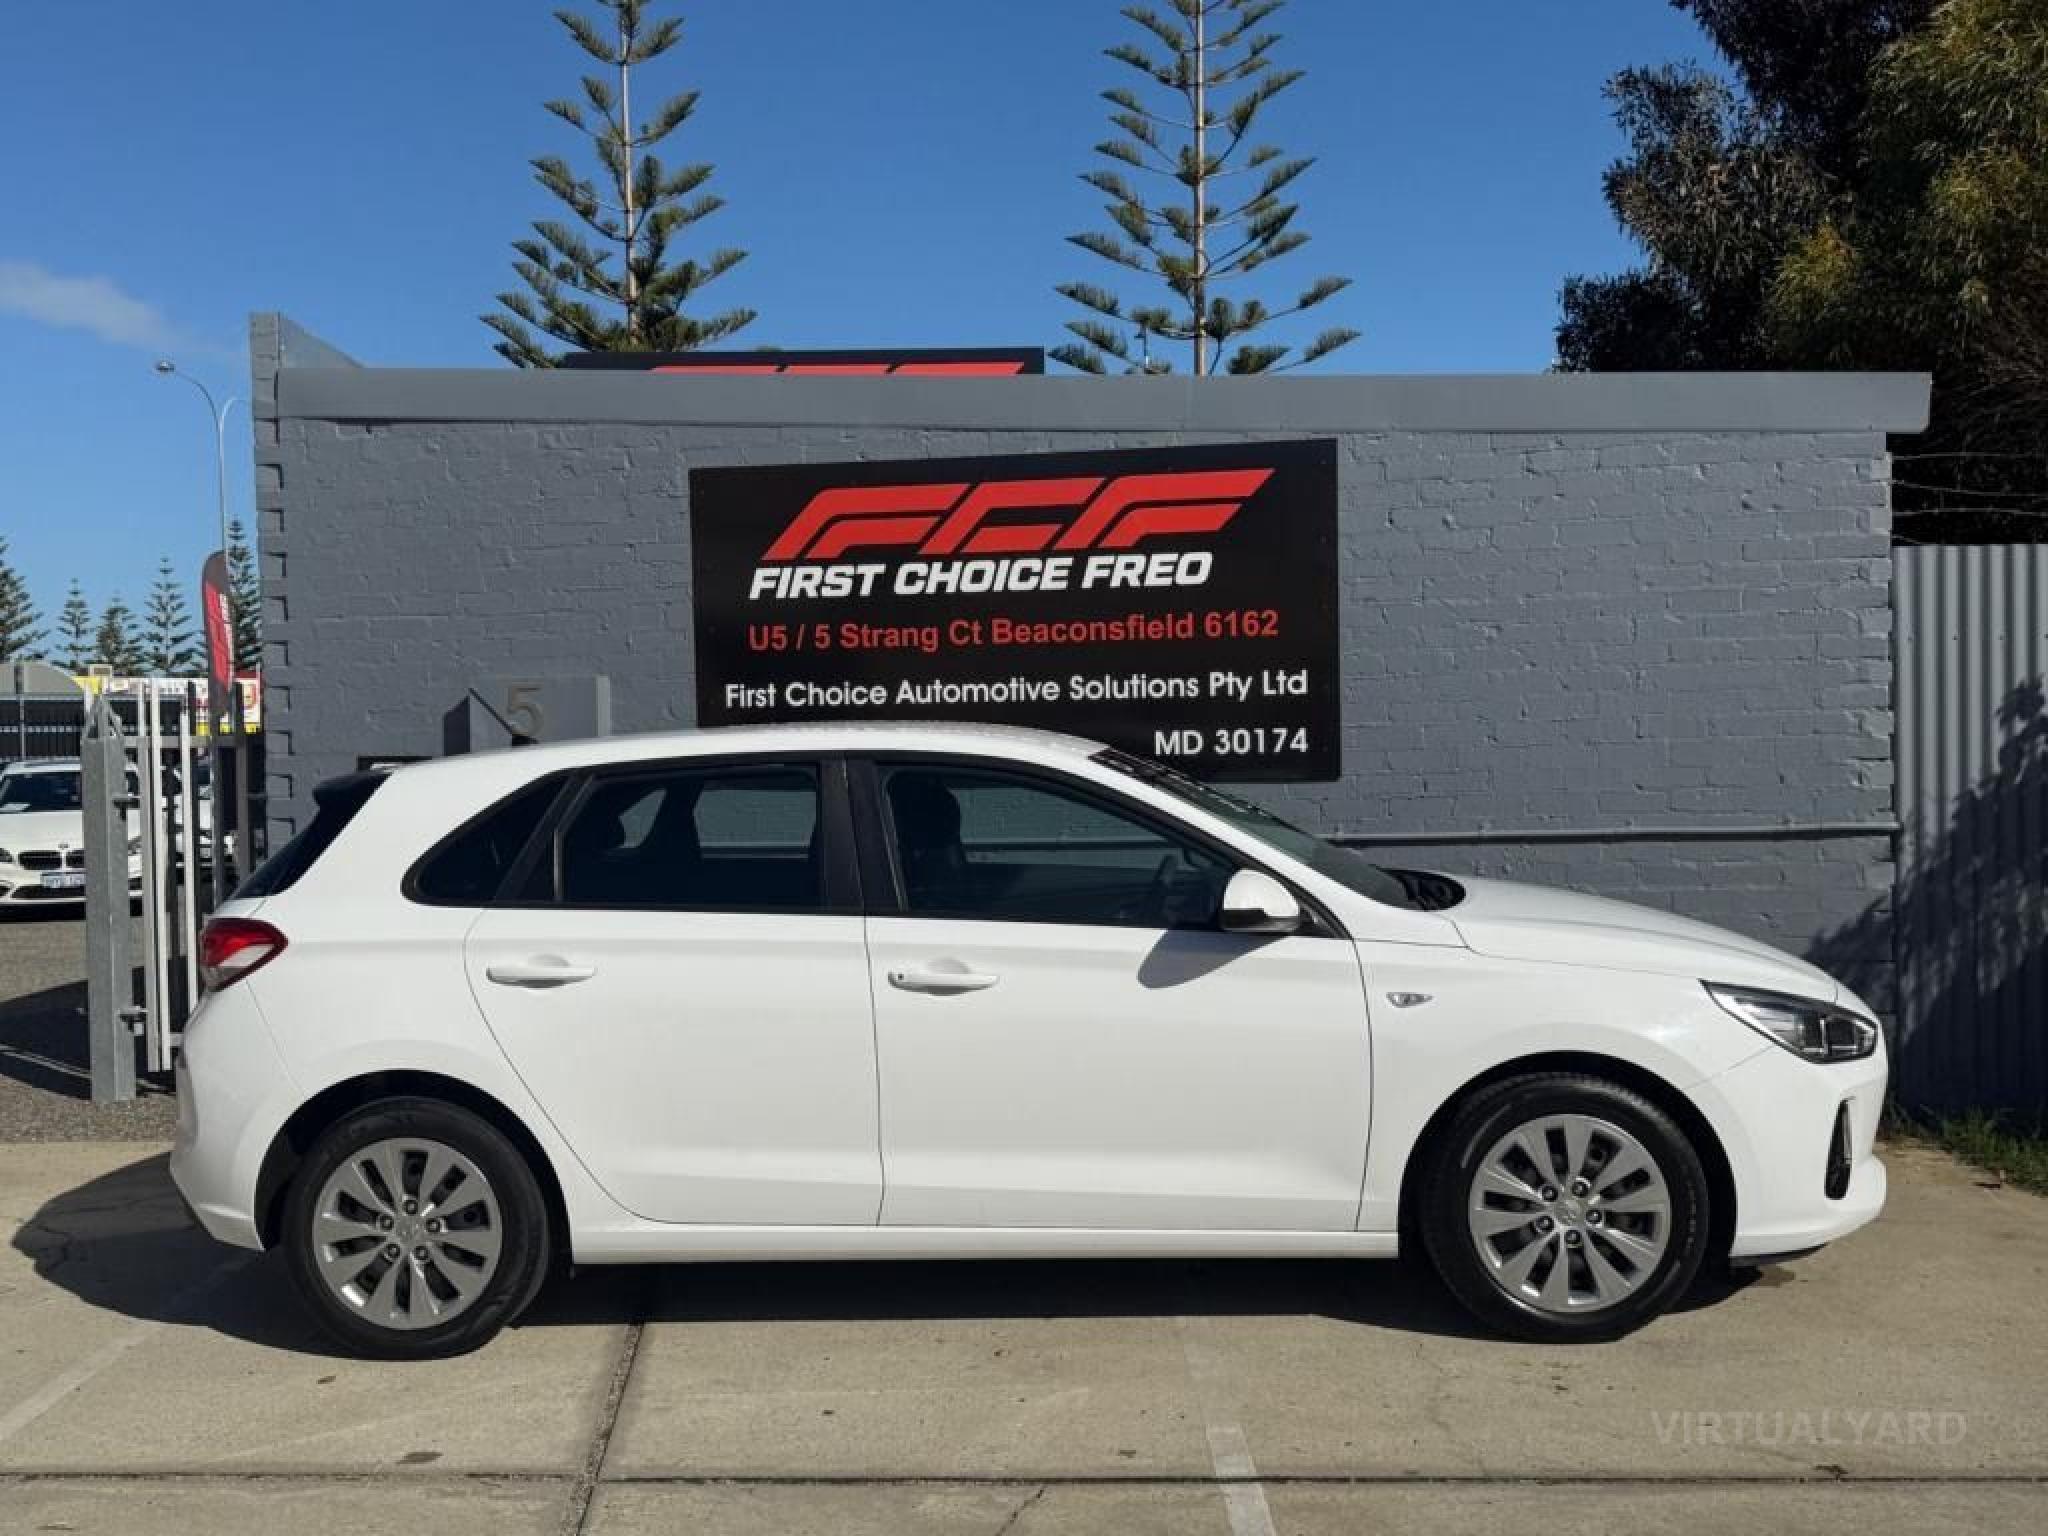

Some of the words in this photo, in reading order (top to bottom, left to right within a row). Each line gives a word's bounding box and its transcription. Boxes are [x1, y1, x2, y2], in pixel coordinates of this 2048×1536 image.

[749, 563, 885, 600] FIRST
[894, 558, 1071, 595] CHOICE
[1081, 551, 1213, 588] FREO
[749, 624, 786, 651] U5
[795, 624, 808, 650] /
[815, 623, 831, 648] 5
[840, 618, 939, 652] Strang
[949, 618, 984, 646] Ct
[992, 612, 1194, 643] Beaconsfield
[1204, 610, 1279, 639] 6162
[506, 683, 544, 735] 5
[725, 682, 777, 709] First
[786, 681, 887, 708] Choice
[896, 677, 1060, 705] Automotive
[1069, 674, 1200, 702] Solutions
[1210, 672, 1253, 702] Pty
[1262, 670, 1308, 696] Ltd
[1154, 731, 1205, 755] MD
[1214, 729, 1308, 753] 30174
